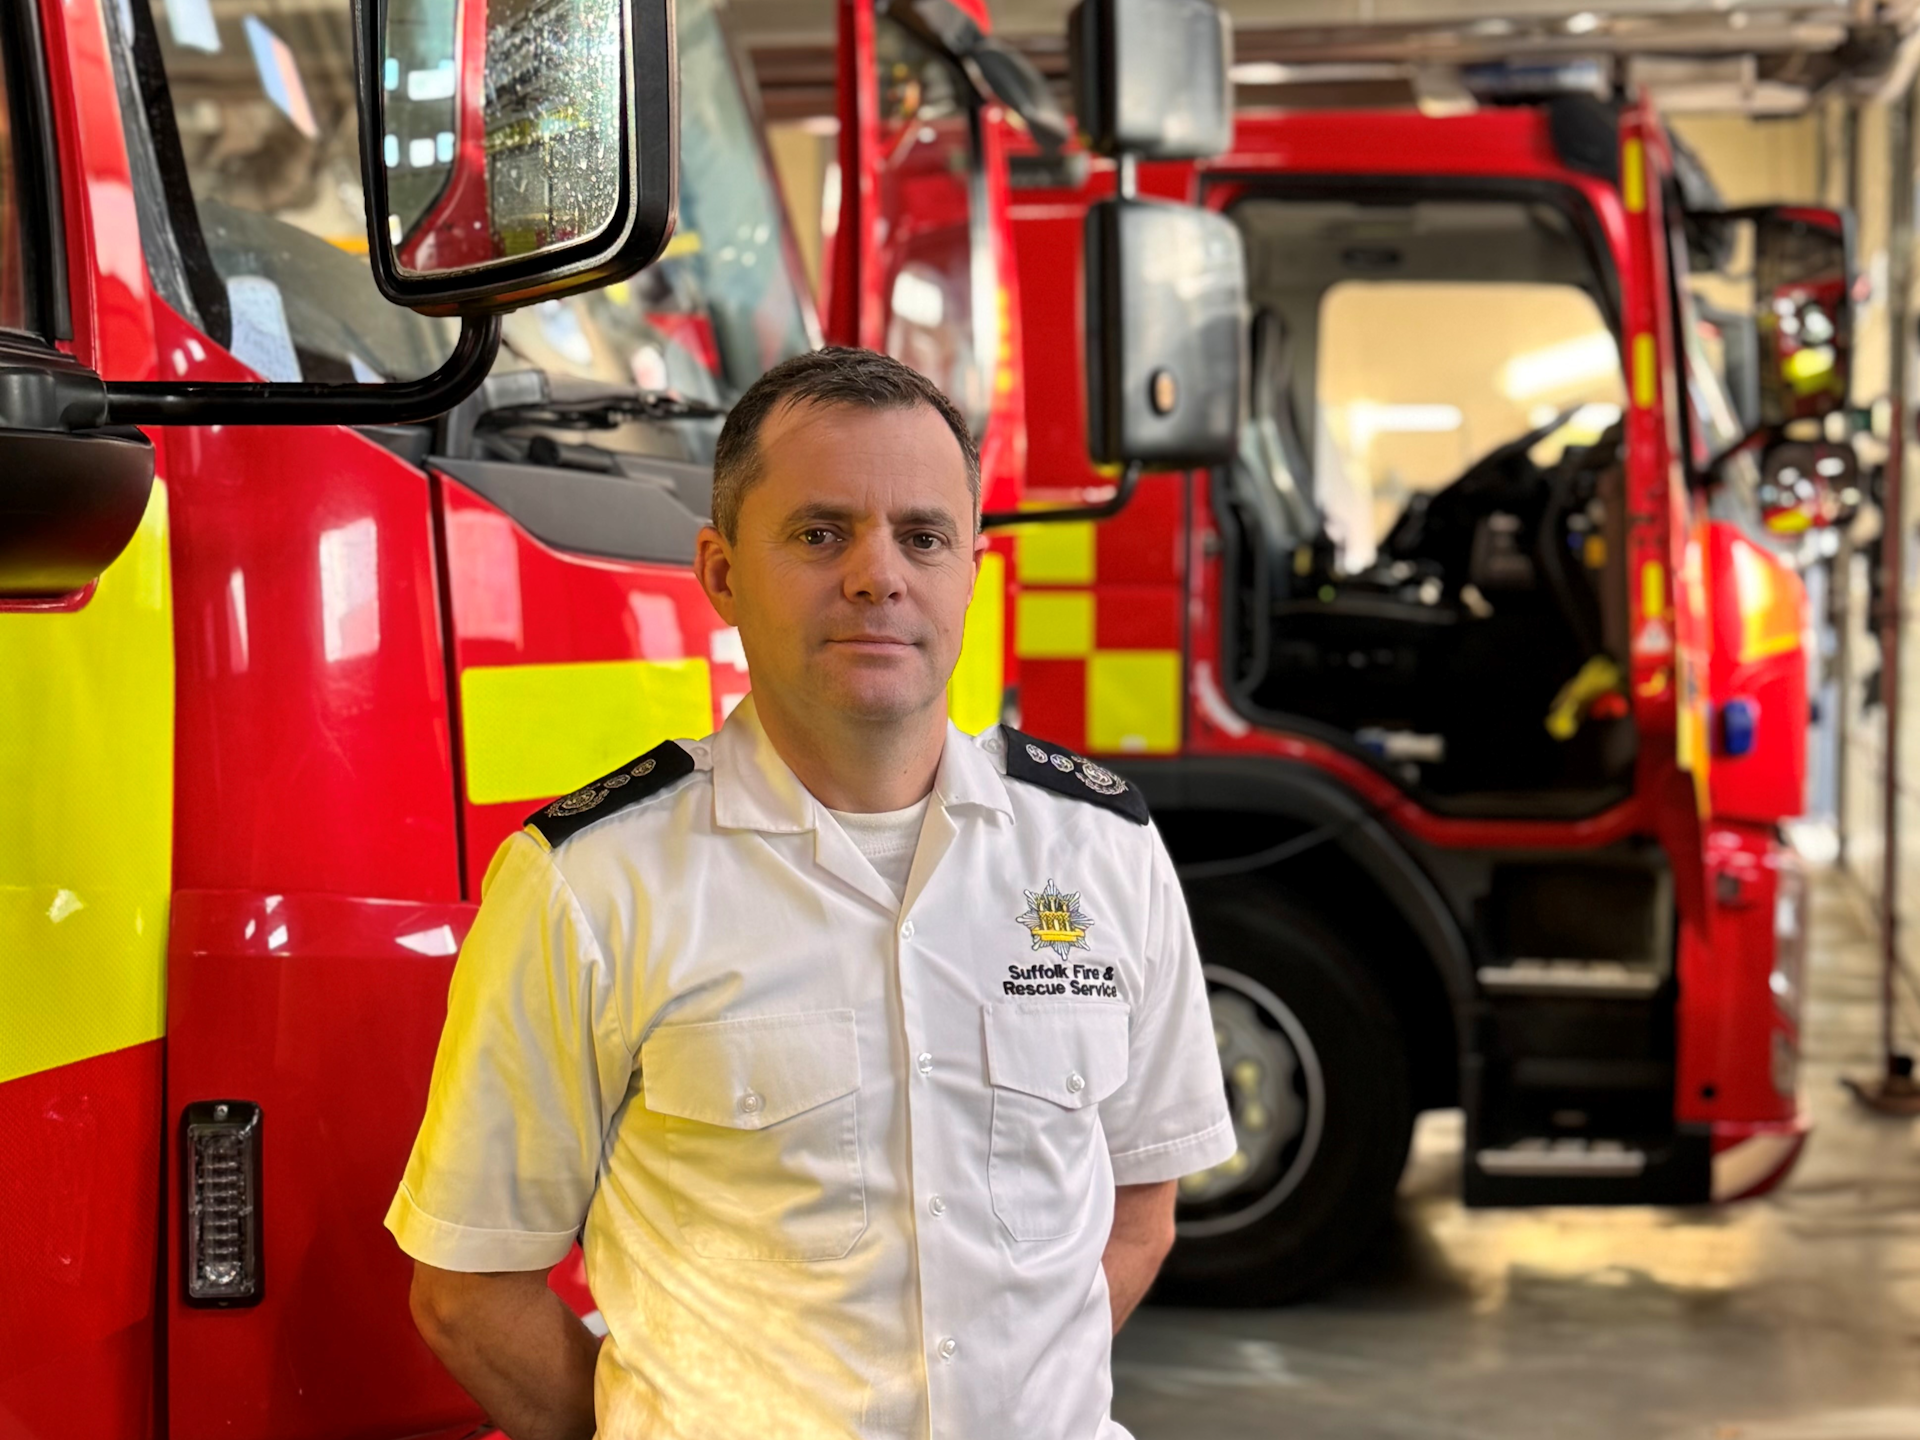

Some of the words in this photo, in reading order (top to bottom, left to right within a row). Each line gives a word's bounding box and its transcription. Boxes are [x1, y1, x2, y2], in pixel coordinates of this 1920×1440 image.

[1008, 964, 1069, 980] Suffolk
[1073, 964, 1100, 980] Fire
[1102, 966, 1114, 981] &
[1003, 981, 1066, 996] Rescue
[1070, 980, 1117, 998] Service
